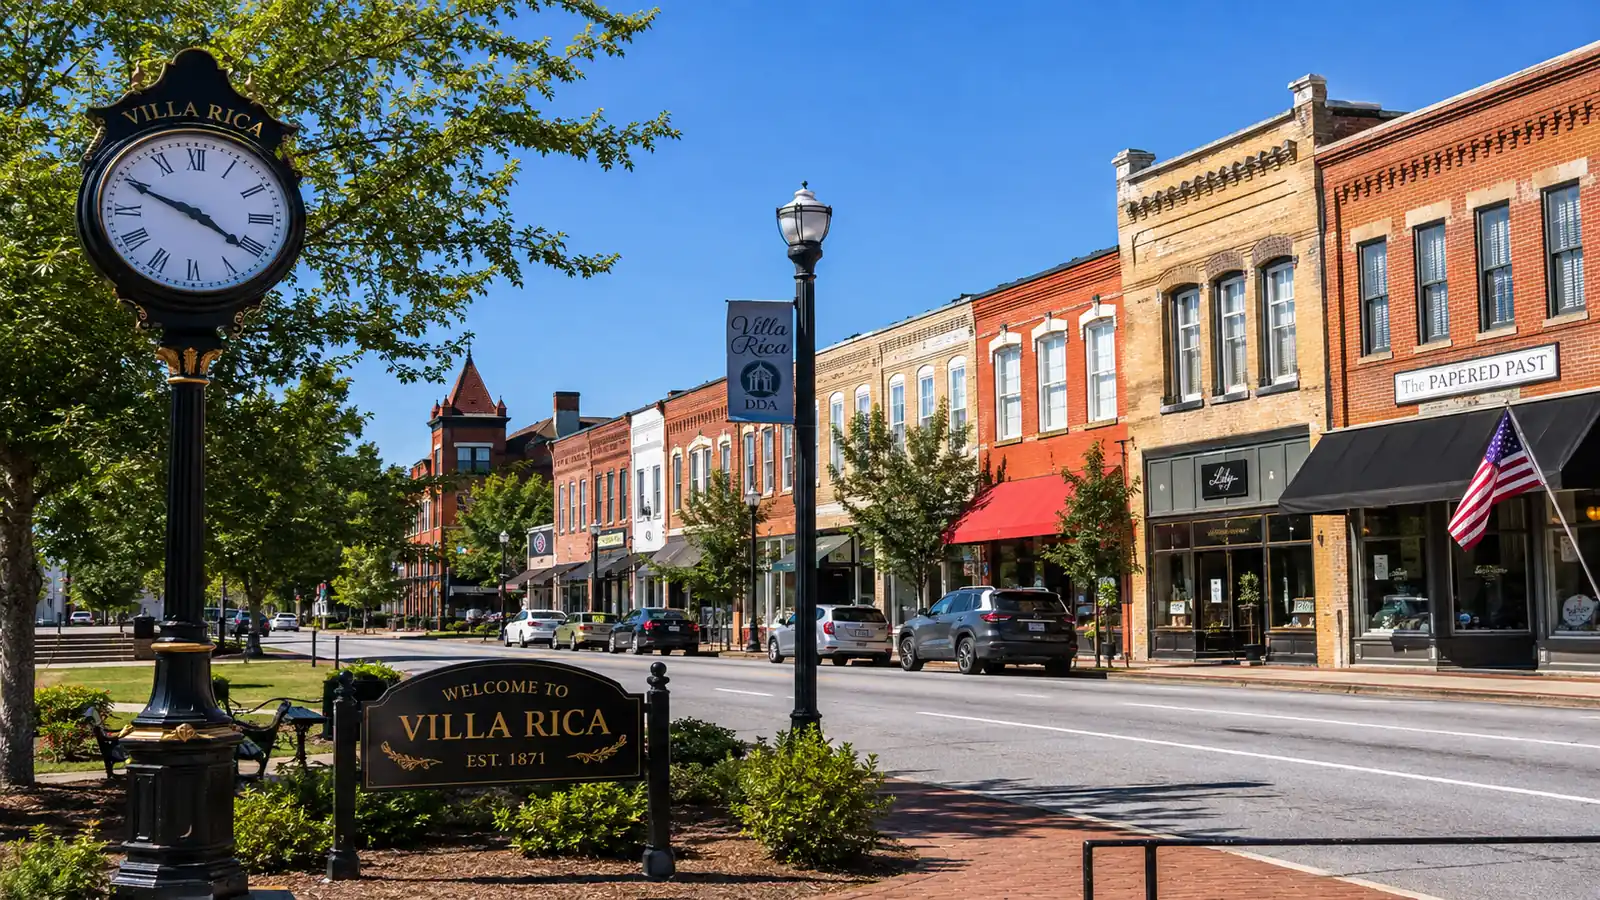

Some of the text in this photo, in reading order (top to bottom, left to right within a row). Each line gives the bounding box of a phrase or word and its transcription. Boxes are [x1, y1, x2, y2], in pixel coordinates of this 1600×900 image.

[121, 101, 264, 139] VILLA RICA
[150, 152, 174, 177] XI
[186, 148, 206, 172] XII
[240, 183, 266, 199] II
[114, 203, 142, 217] IX
[248, 212, 274, 225] III
[120, 227, 151, 251] VIII
[147, 247, 171, 274] VII
[186, 258, 201, 281] VI
[221, 255, 238, 276] V
[731, 315, 789, 336] Villa
[730, 335, 790, 358] Rica
[1401, 354, 1548, 395] The PAPERED PAST
[745, 399, 778, 411] DDA
[442, 680, 569, 702] WELCOME TO
[398, 708, 612, 742] VILLA RICA
[467, 752, 546, 768] EST. 1871
